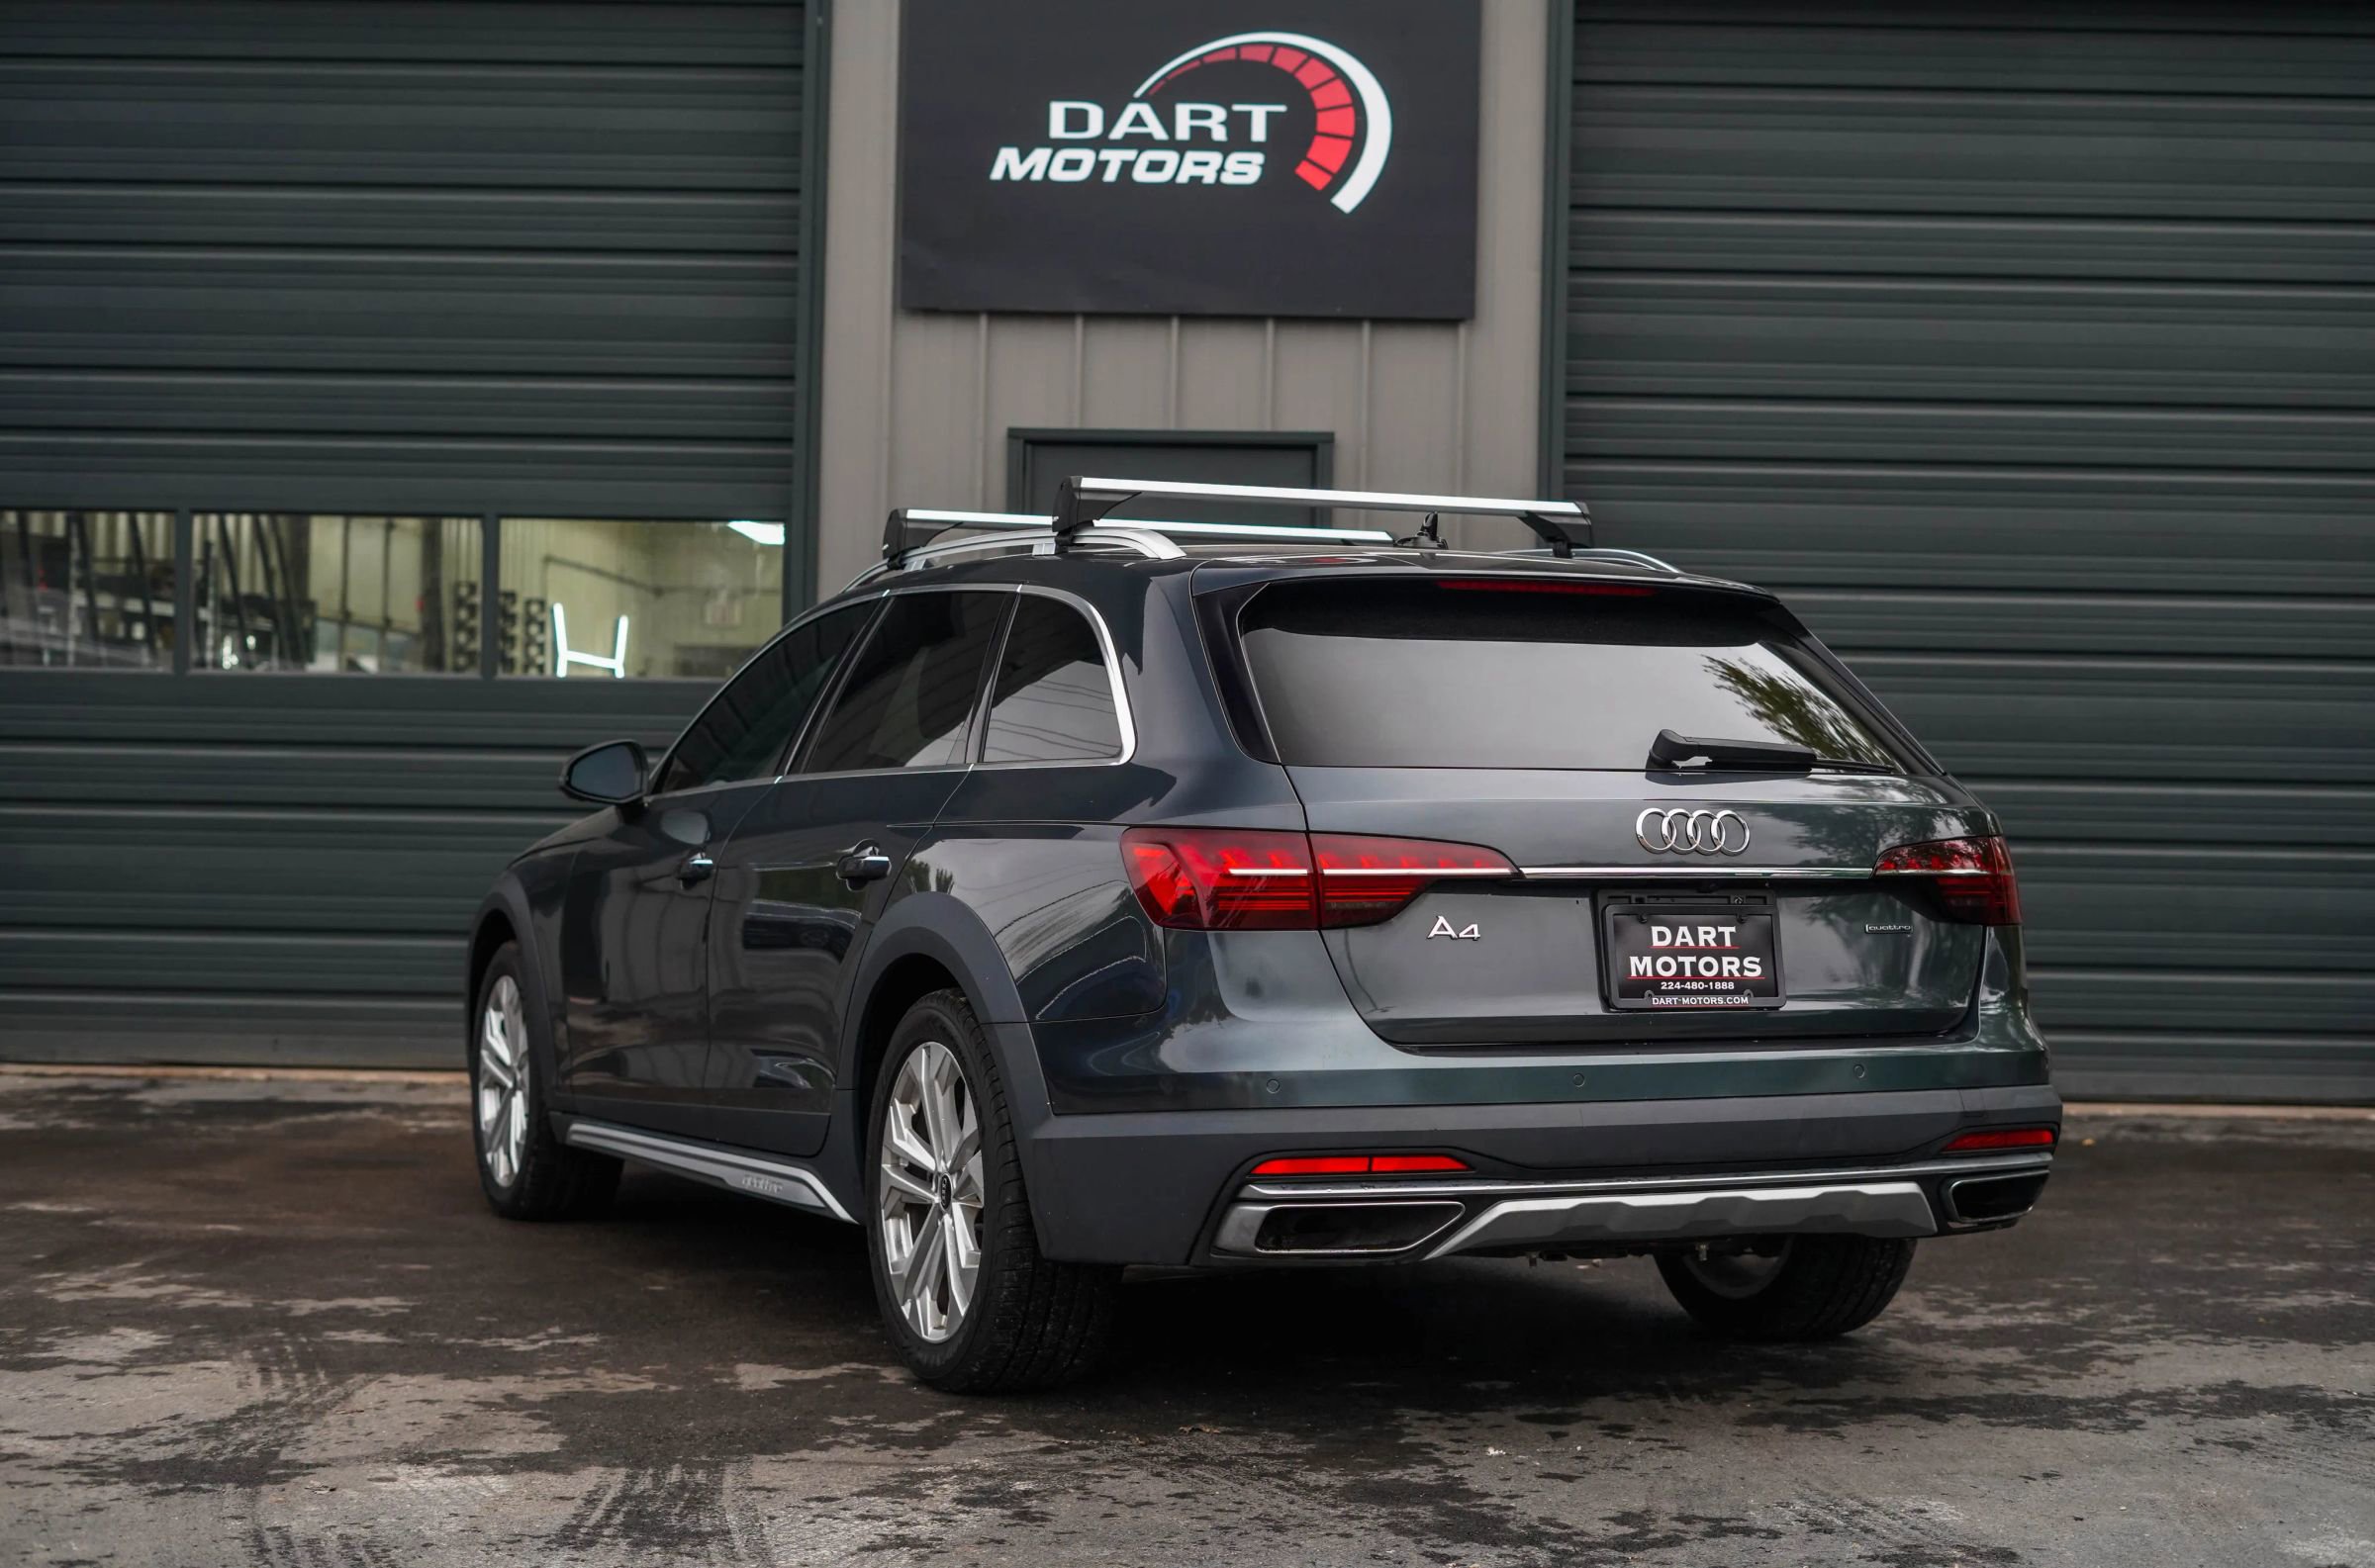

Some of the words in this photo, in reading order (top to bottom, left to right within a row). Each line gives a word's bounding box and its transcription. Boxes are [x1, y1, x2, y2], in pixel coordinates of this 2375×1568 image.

[1049, 101, 1286, 142] DART
[990, 147, 1265, 185] MOTORS
[1427, 915, 1480, 940] A4
[1651, 926, 1736, 947] DART
[1629, 956, 1762, 977] MOTORS
[1660, 981, 1735, 990] 224-480-1888
[1652, 996, 1749, 1005] DART-MOTORS.COM
